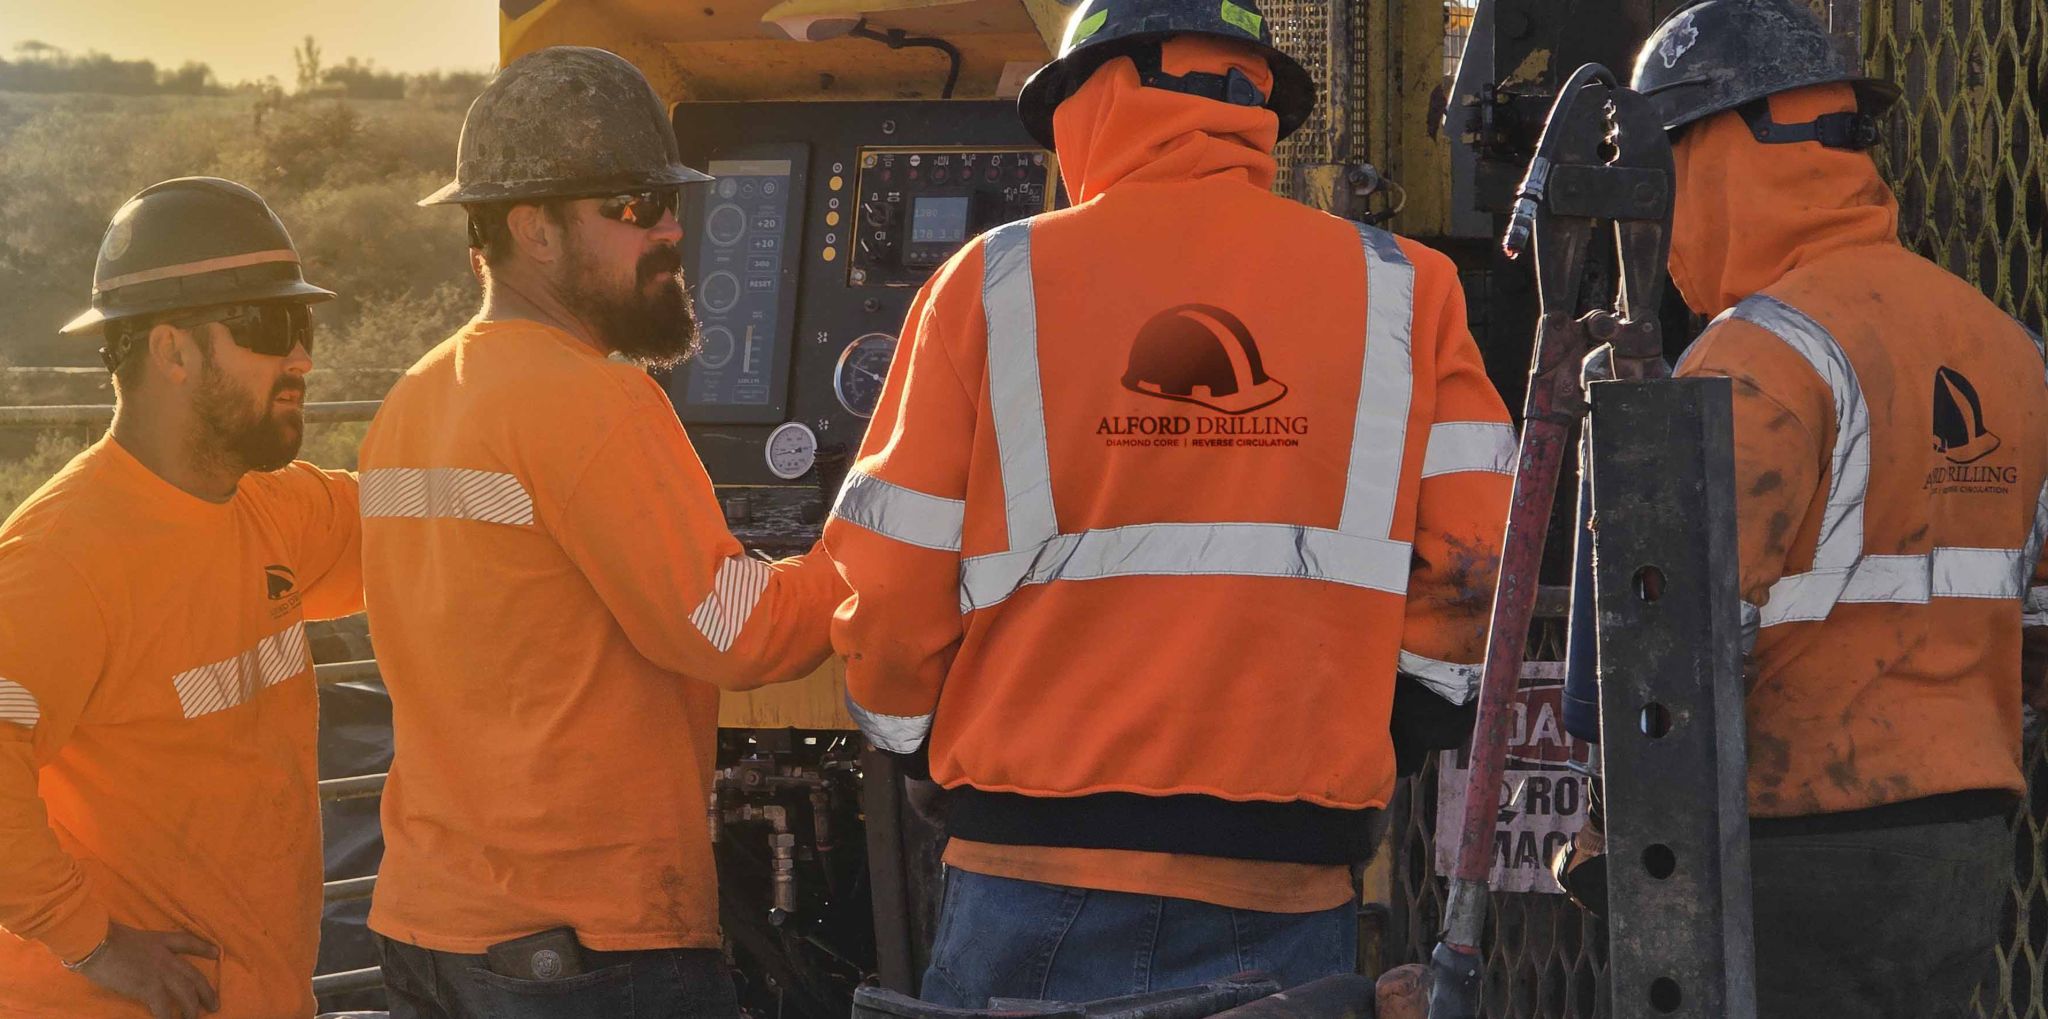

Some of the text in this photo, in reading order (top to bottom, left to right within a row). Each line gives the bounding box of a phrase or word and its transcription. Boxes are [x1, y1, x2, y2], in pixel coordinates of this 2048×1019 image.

[757, 219, 776, 228] +20
[754, 239, 774, 248] +10
[749, 280, 772, 288] RESET
[1096, 416, 1309, 435] ALFORD DRILLING
[1106, 439, 1299, 447] DIAMOND CORE REVERSE CIRCULATION
[1507, 702, 1575, 747] DA
[1526, 776, 1589, 816] RO
